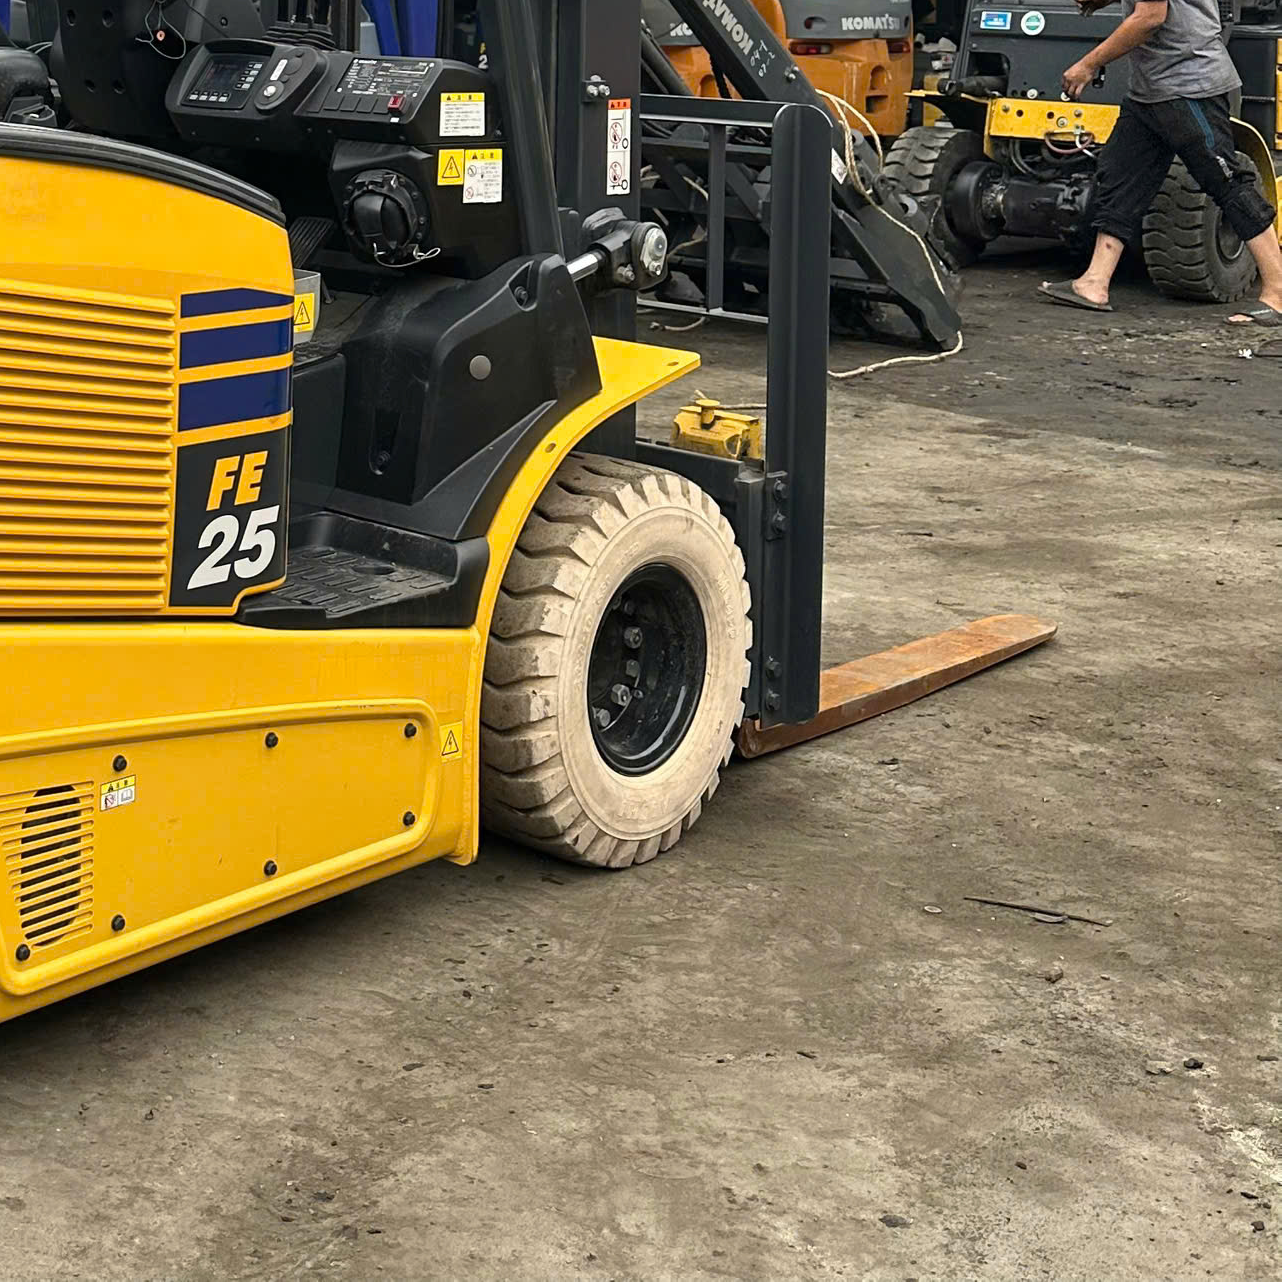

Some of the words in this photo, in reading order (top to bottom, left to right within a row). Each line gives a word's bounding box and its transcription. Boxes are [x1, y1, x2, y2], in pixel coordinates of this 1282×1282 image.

[841, 13, 900, 31] KOMATSU
[205, 450, 269, 512] FE
[186, 504, 280, 590] 25
